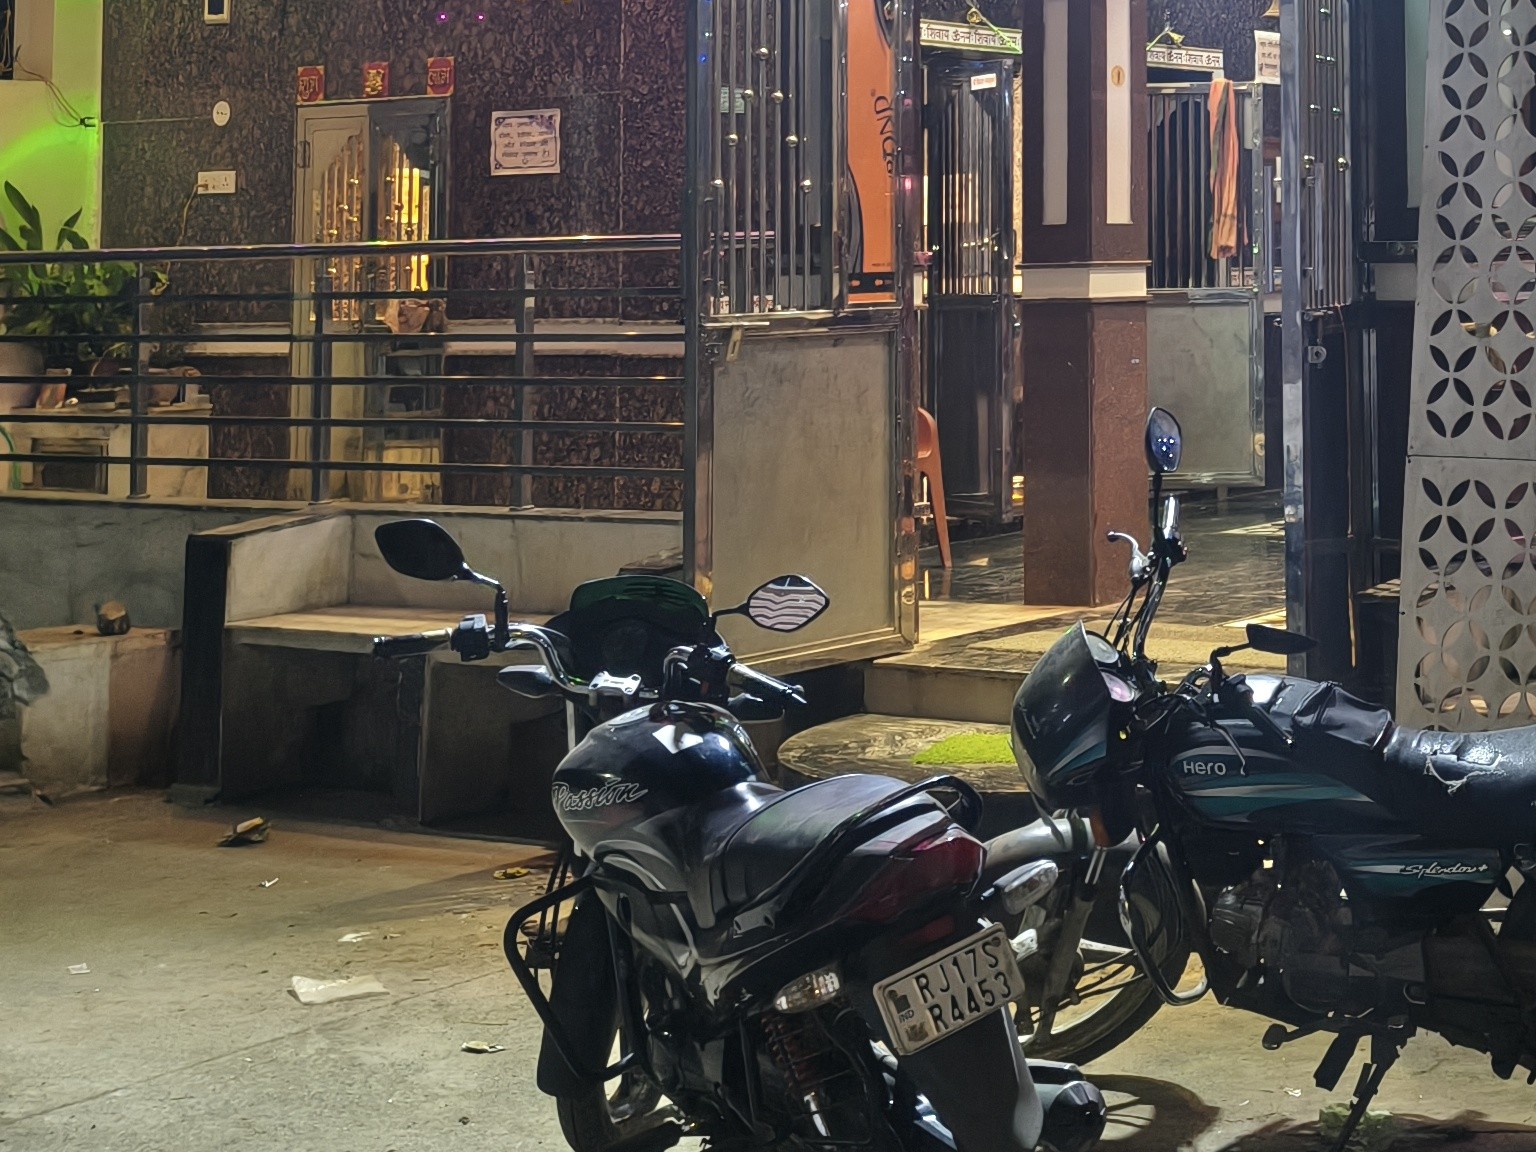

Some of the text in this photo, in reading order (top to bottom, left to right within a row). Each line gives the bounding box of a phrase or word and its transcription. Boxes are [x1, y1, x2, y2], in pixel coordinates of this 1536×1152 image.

[1182, 760, 1227, 776] Hero
[552, 776, 649, 811] Passion
[914, 940, 1000, 1004] RJ17S
[927, 971, 1012, 1033] R4453
